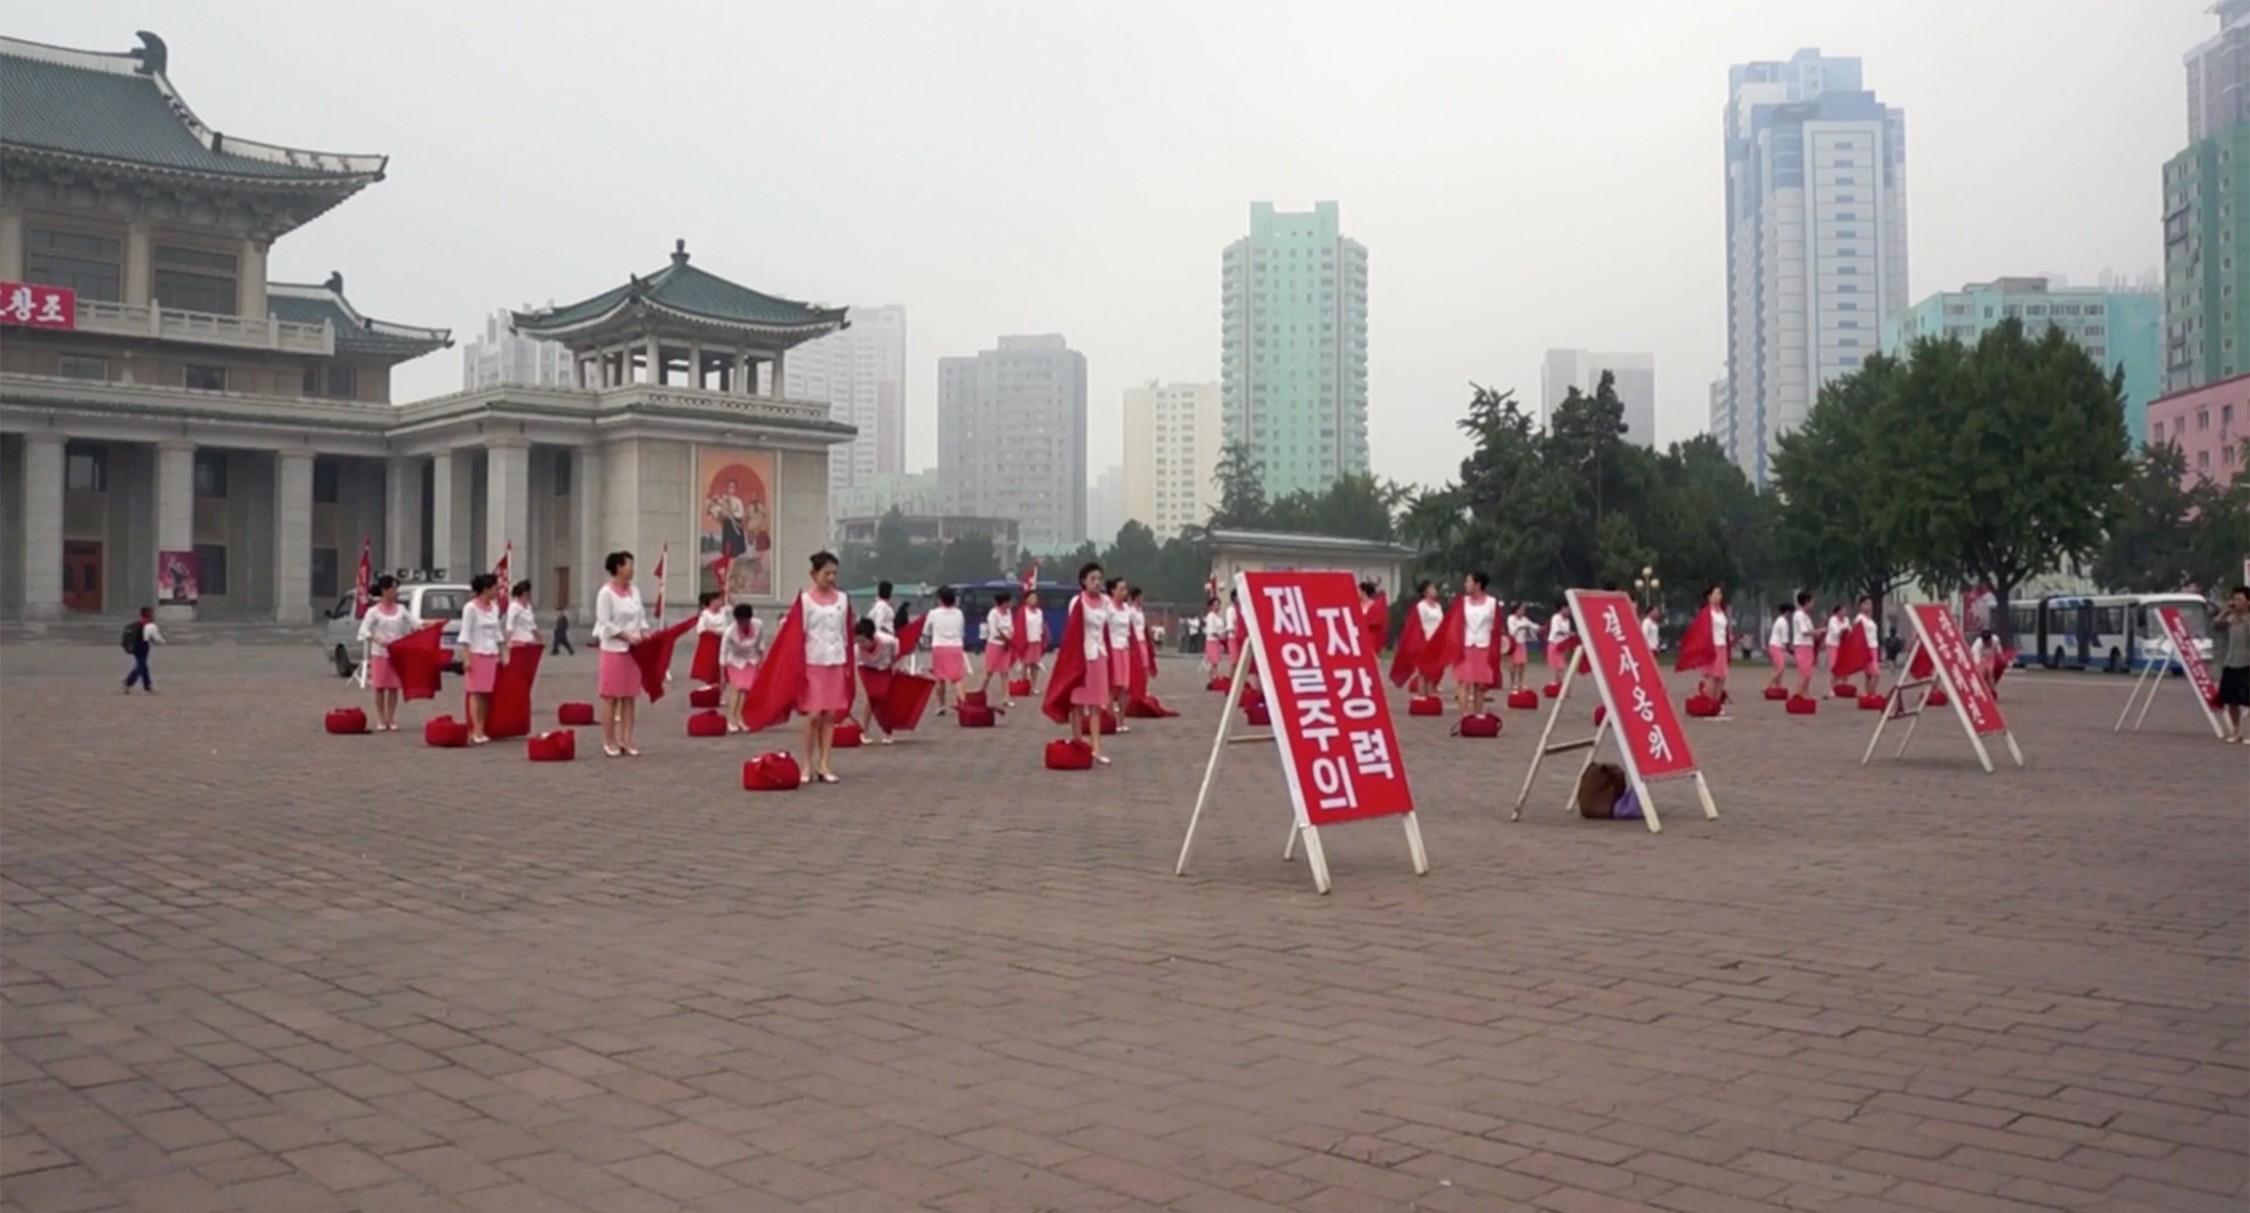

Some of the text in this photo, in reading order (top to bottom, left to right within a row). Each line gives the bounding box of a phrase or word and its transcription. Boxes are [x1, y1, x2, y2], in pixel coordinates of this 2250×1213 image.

[0, 286, 65, 322] 창조
[1262, 586, 1358, 809] 제일주의
[1316, 606, 1394, 780] 자강력
[1602, 604, 1673, 762] 결사옹위
